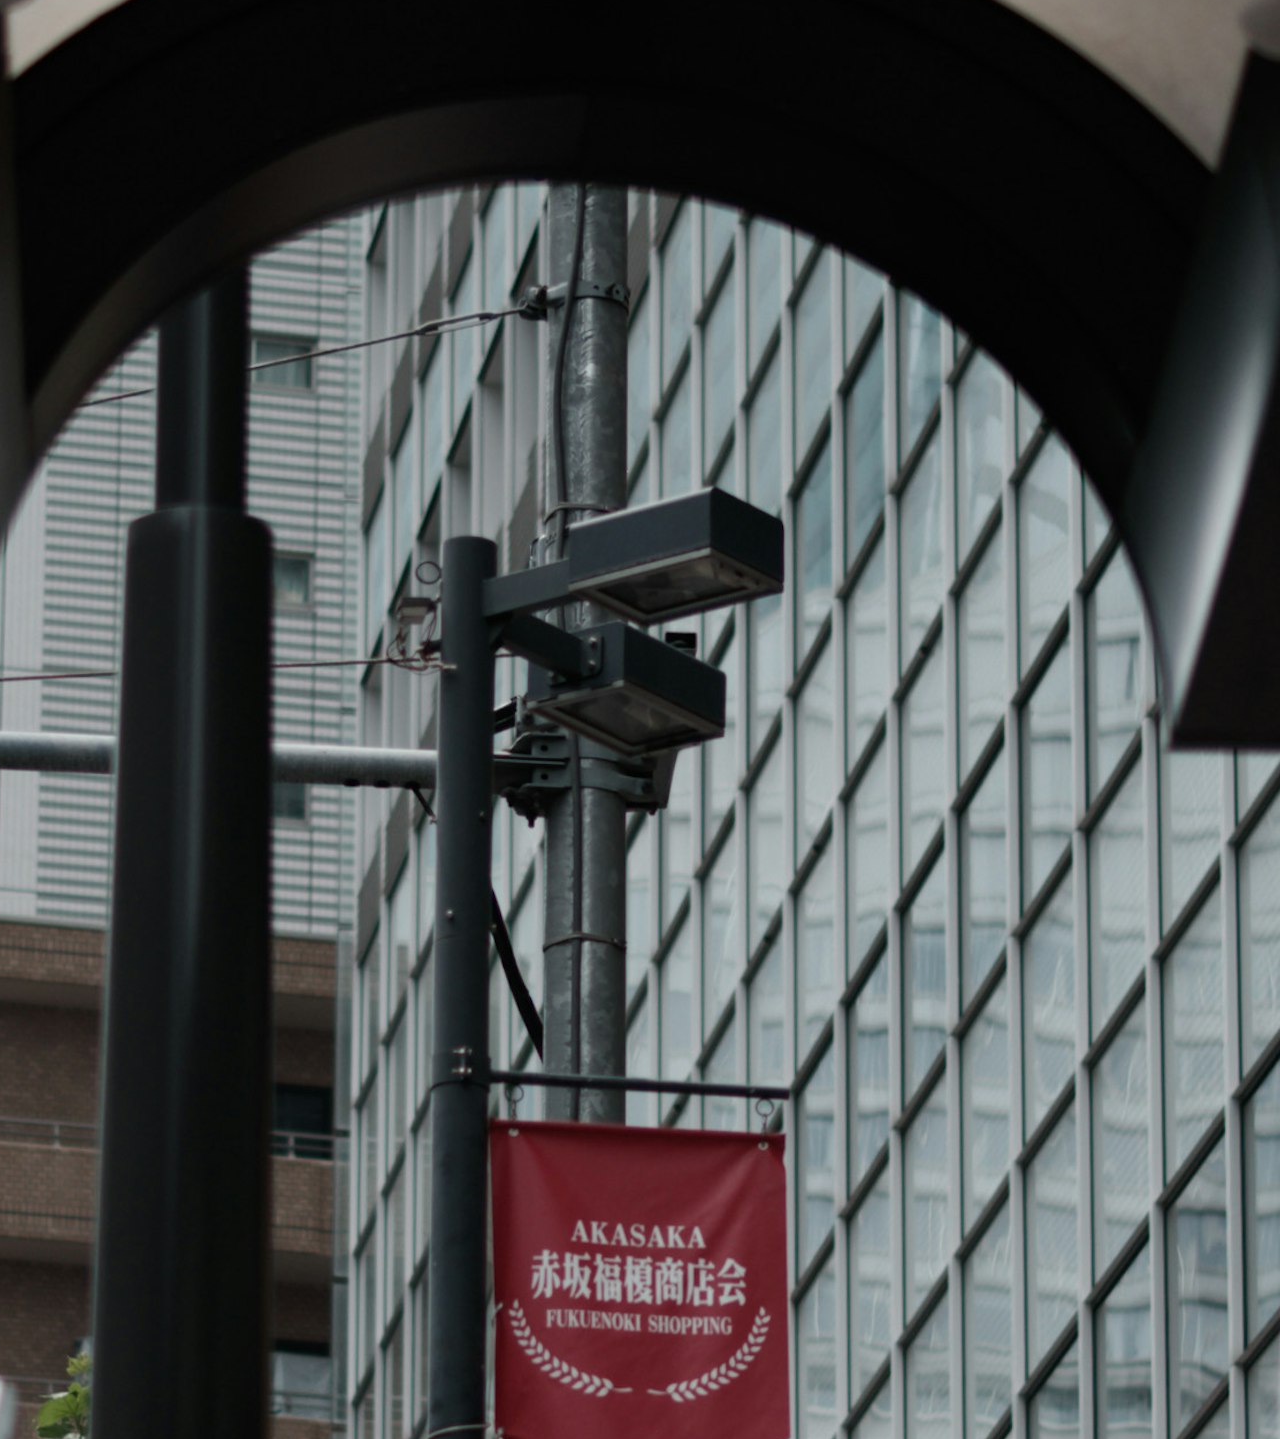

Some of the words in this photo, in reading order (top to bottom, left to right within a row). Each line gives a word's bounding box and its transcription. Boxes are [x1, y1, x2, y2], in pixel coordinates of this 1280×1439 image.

[571, 1219, 706, 1249] AKASAKA
[531, 1249, 747, 1307] 赤坂福榎商店会
[546, 1309, 641, 1332] FUKUENOKI
[648, 1314, 733, 1335] SHOPPING
